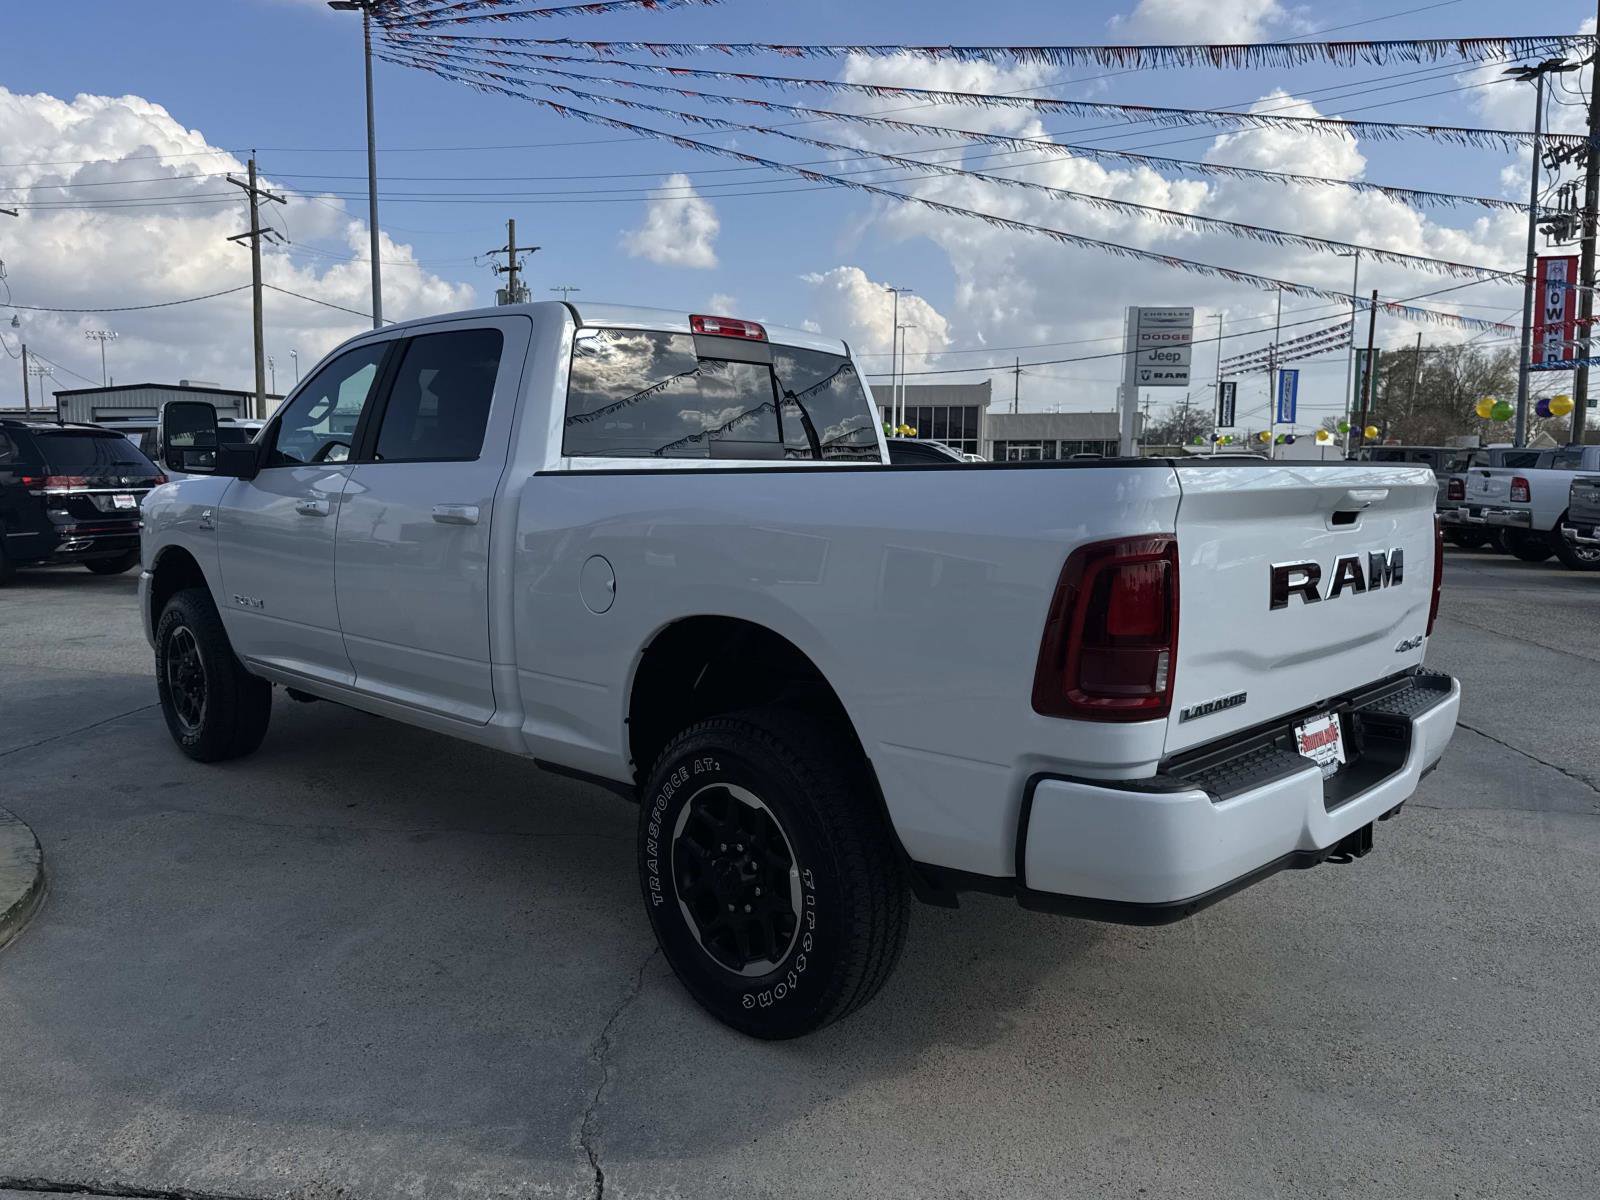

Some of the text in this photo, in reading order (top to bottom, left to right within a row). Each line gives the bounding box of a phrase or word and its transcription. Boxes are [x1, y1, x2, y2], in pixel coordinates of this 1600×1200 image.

[1141, 333, 1190, 341] DODGE
[1149, 348, 1181, 363] Jeep
[1269, 547, 1404, 611] RAM
[1178, 690, 1247, 725] LARAMIE
[646, 765, 690, 906] TRANSFORCE
